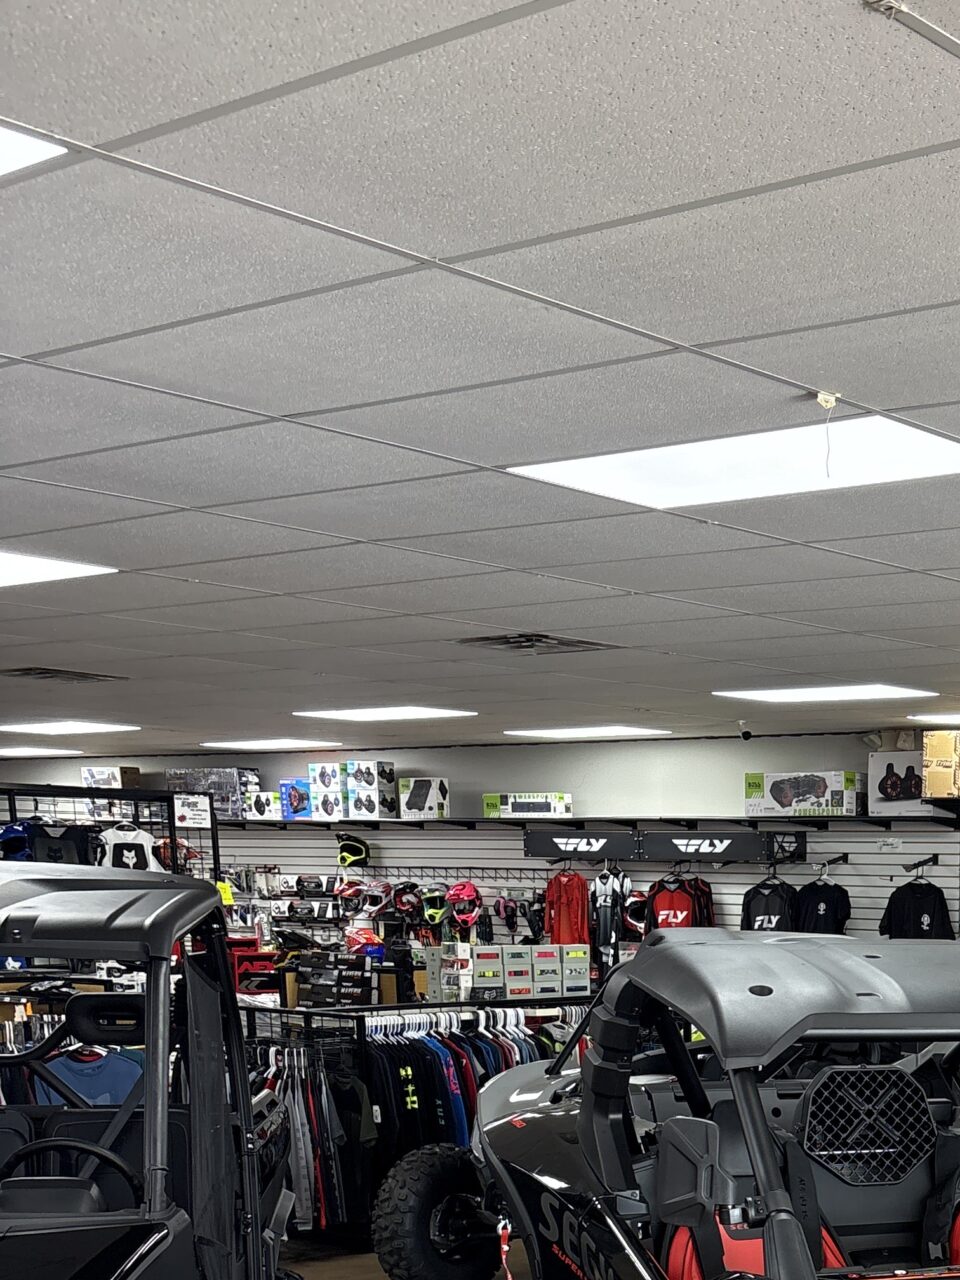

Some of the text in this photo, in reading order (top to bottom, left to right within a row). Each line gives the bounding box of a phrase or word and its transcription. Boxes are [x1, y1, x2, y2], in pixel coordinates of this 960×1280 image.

[508, 793, 558, 801] PWERSPOTS
[794, 807, 844, 816] POWERSPORTS
[558, 837, 608, 853] FLY
[678, 838, 733, 854] FLY
[658, 910, 689, 924] FLY
[754, 914, 781, 930] FLY
[552, 1243, 584, 1280] SUPER
